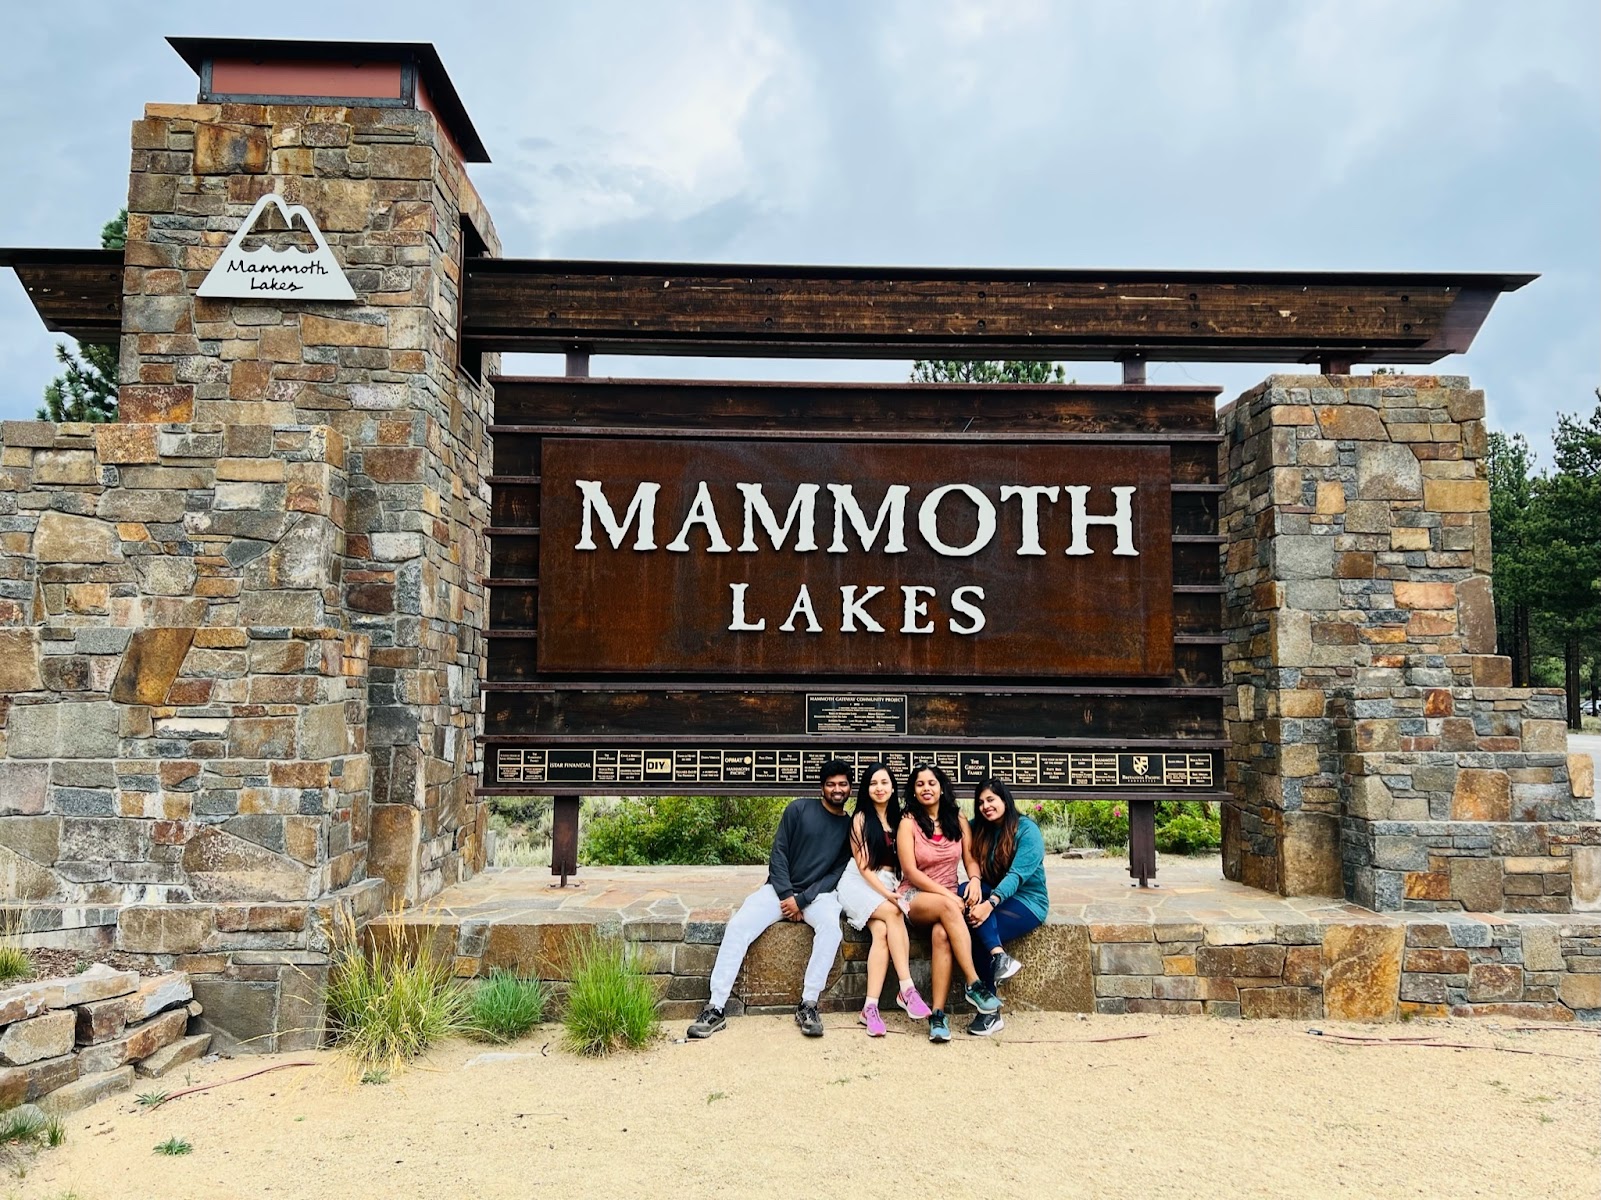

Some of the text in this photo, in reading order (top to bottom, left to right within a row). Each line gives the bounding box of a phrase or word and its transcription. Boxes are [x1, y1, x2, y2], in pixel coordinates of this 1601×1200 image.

[226, 260, 328, 275] Mammoth
[250, 277, 304, 292] Lakes
[574, 479, 1140, 557] MAMMOTH
[727, 582, 987, 634] LAKES
[647, 761, 665, 770] DIY
